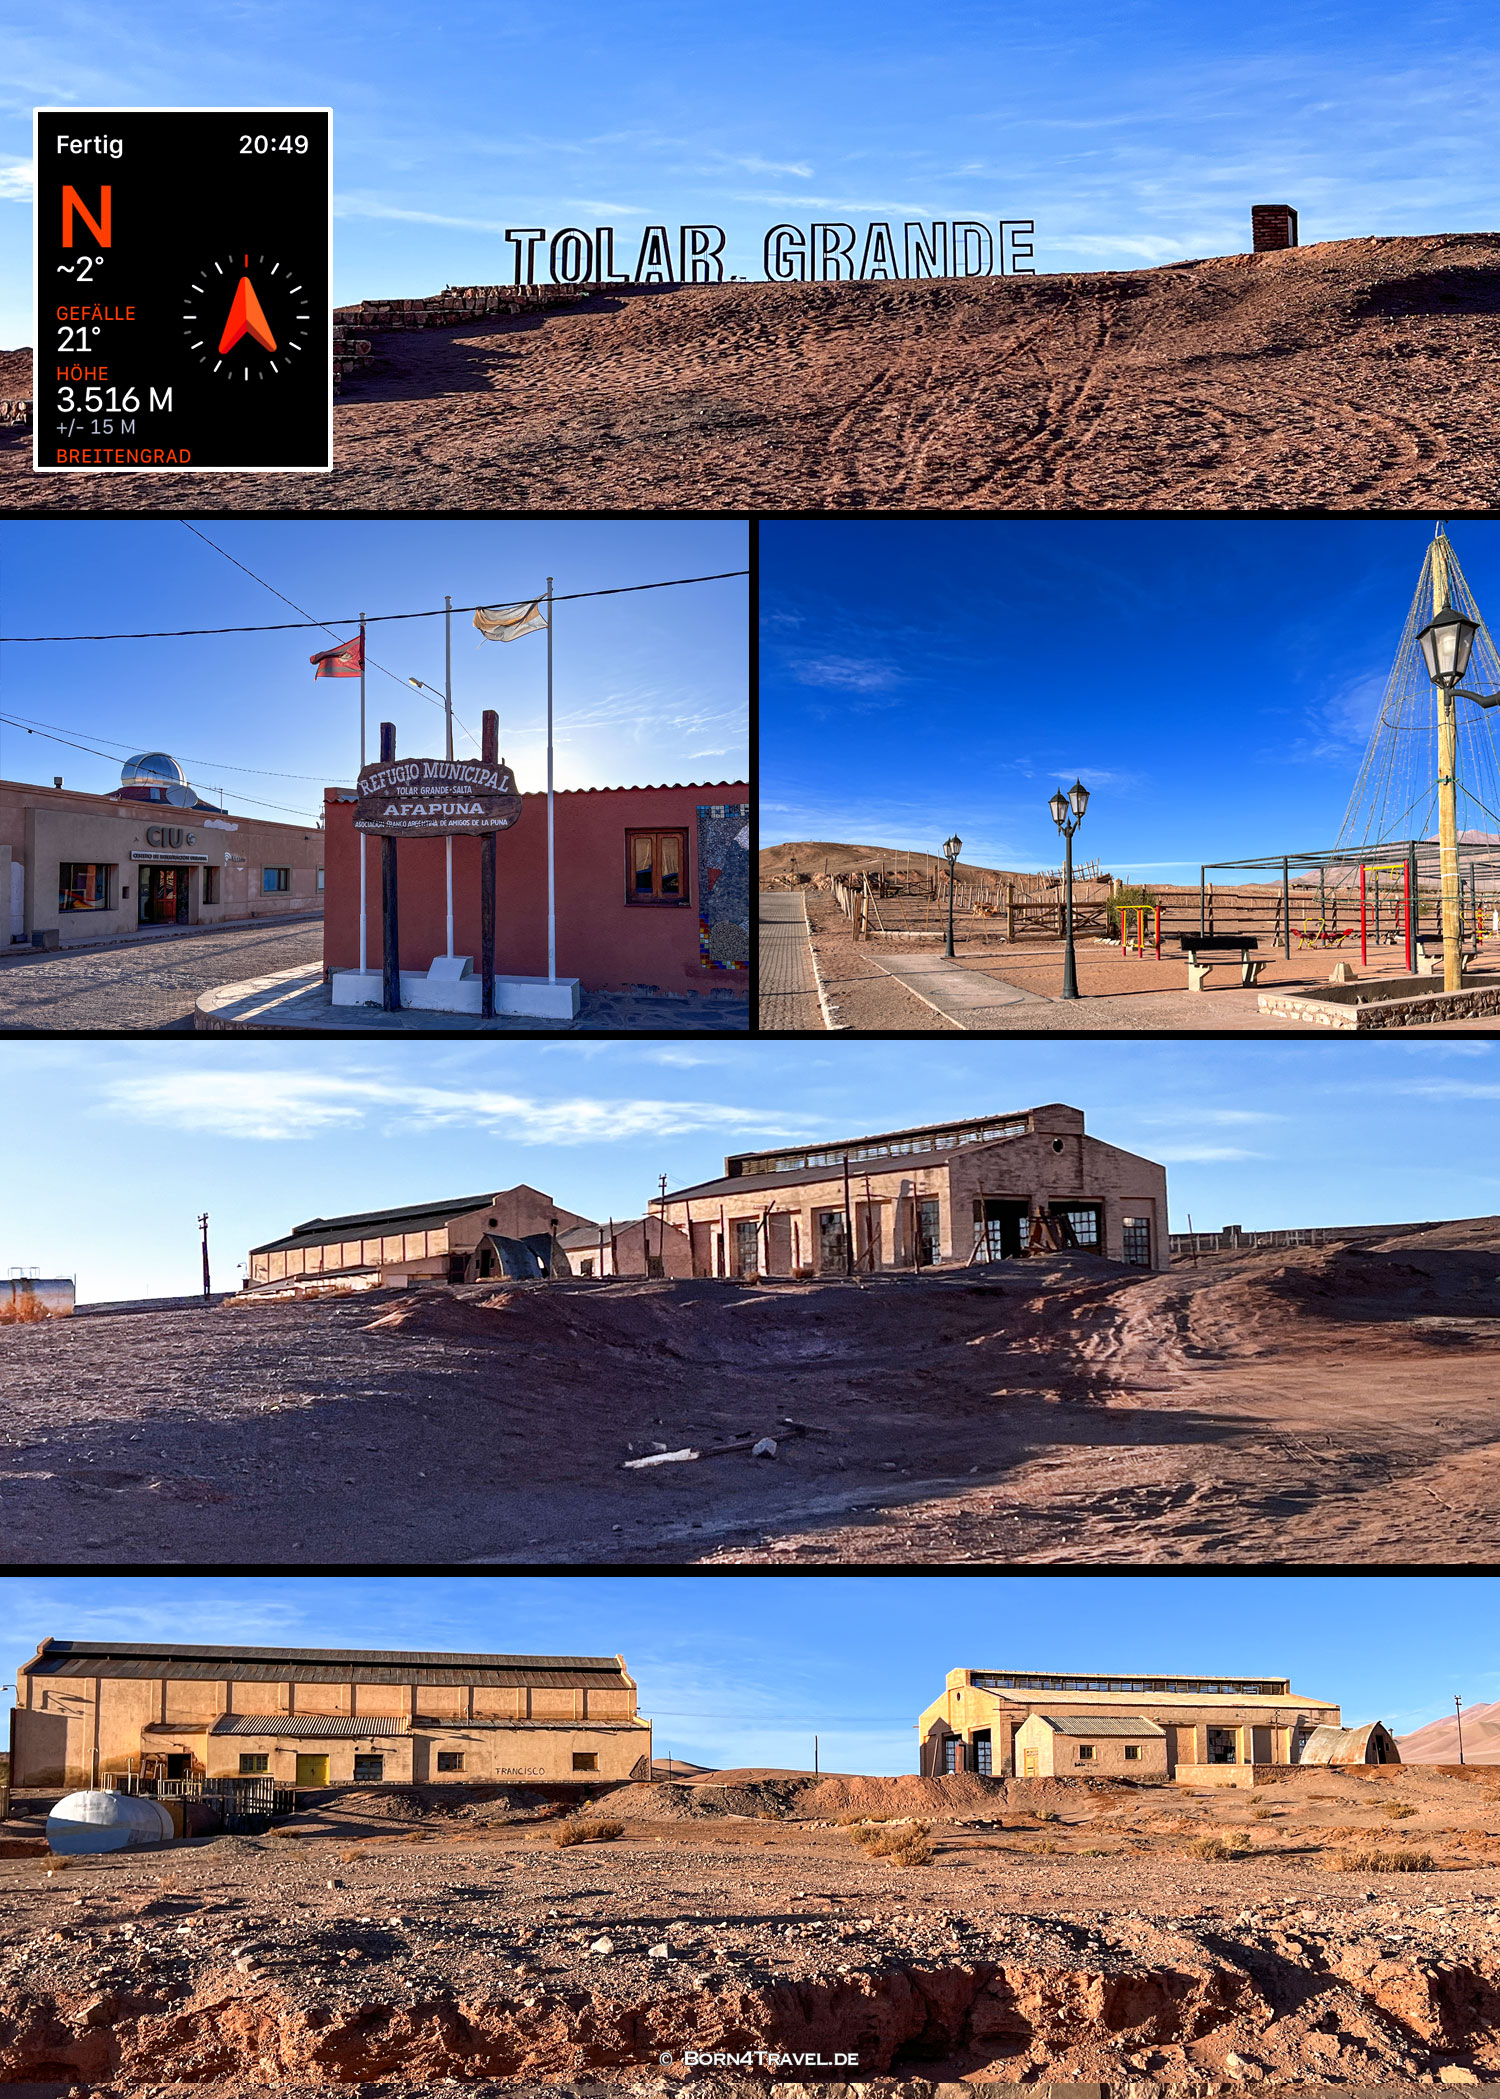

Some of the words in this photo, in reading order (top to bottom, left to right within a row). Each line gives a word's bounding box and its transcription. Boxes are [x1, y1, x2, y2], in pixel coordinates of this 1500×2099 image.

[57, 134, 123, 159] Fertig
[239, 134, 309, 155] 20:49
[61, 184, 112, 249] N
[505, 225, 726, 285] TOLAR
[764, 220, 1035, 282] GRANDE
[56, 255, 105, 282] ~2°
[56, 304, 136, 321] GEFÄLLE
[57, 325, 101, 352] 21°
[56, 364, 109, 381] HÖHE
[56, 386, 141, 413] 3.516
[149, 386, 173, 413] M
[56, 419, 84, 438] +/-
[91, 418, 114, 435] 15
[121, 418, 135, 435] M
[56, 448, 191, 464] BREITENGRAD
[359, 763, 420, 796] REFUGIO
[423, 762, 510, 793] MUNICIPAL
[396, 786, 418, 795] TOLAR
[383, 802, 485, 816] AFAPUNA
[448, 819, 470, 827] AMIGOS
[471, 818, 480, 826] DE
[481, 818, 490, 826] LA
[490, 818, 509, 826] PUNA
[146, 825, 184, 848] CIU
[495, 1767, 546, 1776] FRANCISCO
